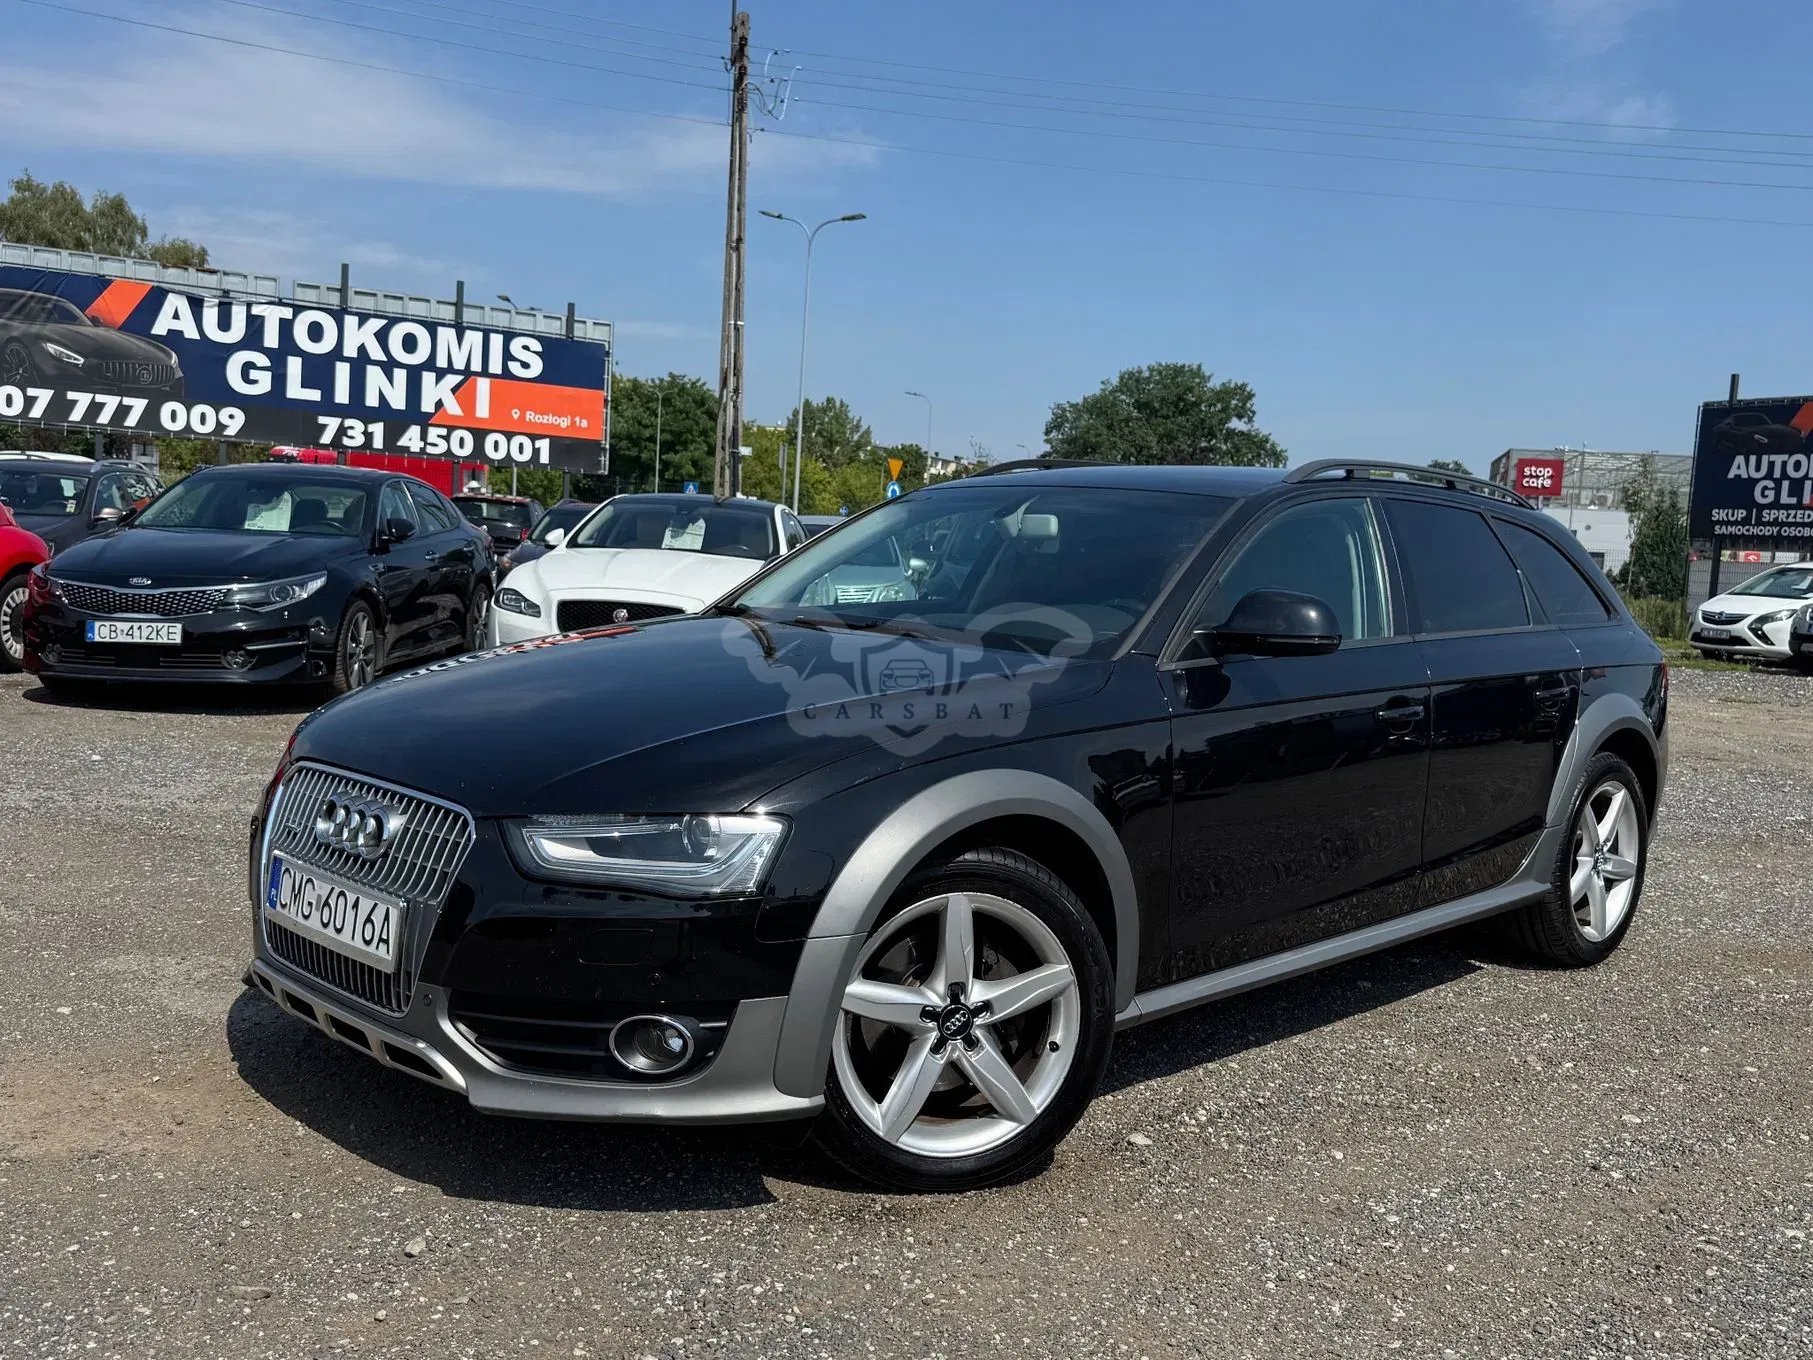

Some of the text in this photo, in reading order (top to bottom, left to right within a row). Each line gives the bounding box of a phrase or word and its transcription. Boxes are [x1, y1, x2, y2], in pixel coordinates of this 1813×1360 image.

[151, 292, 543, 379] AUTOKOMIS
[225, 349, 491, 419] GLINKI
[66, 390, 149, 427] 777
[159, 401, 246, 436] 009
[574, 416, 588, 428] 1a
[317, 415, 550, 464] 731 450 001
[1523, 465, 1552, 479] stop
[1727, 453, 1813, 479] AUTO
[1711, 508, 1746, 521] SKUP
[1714, 525, 1780, 536] SAMOCHODY
[98, 624, 118, 640] CB
[125, 624, 178, 641] 412KE
[278, 867, 391, 954] CMG 6016A
